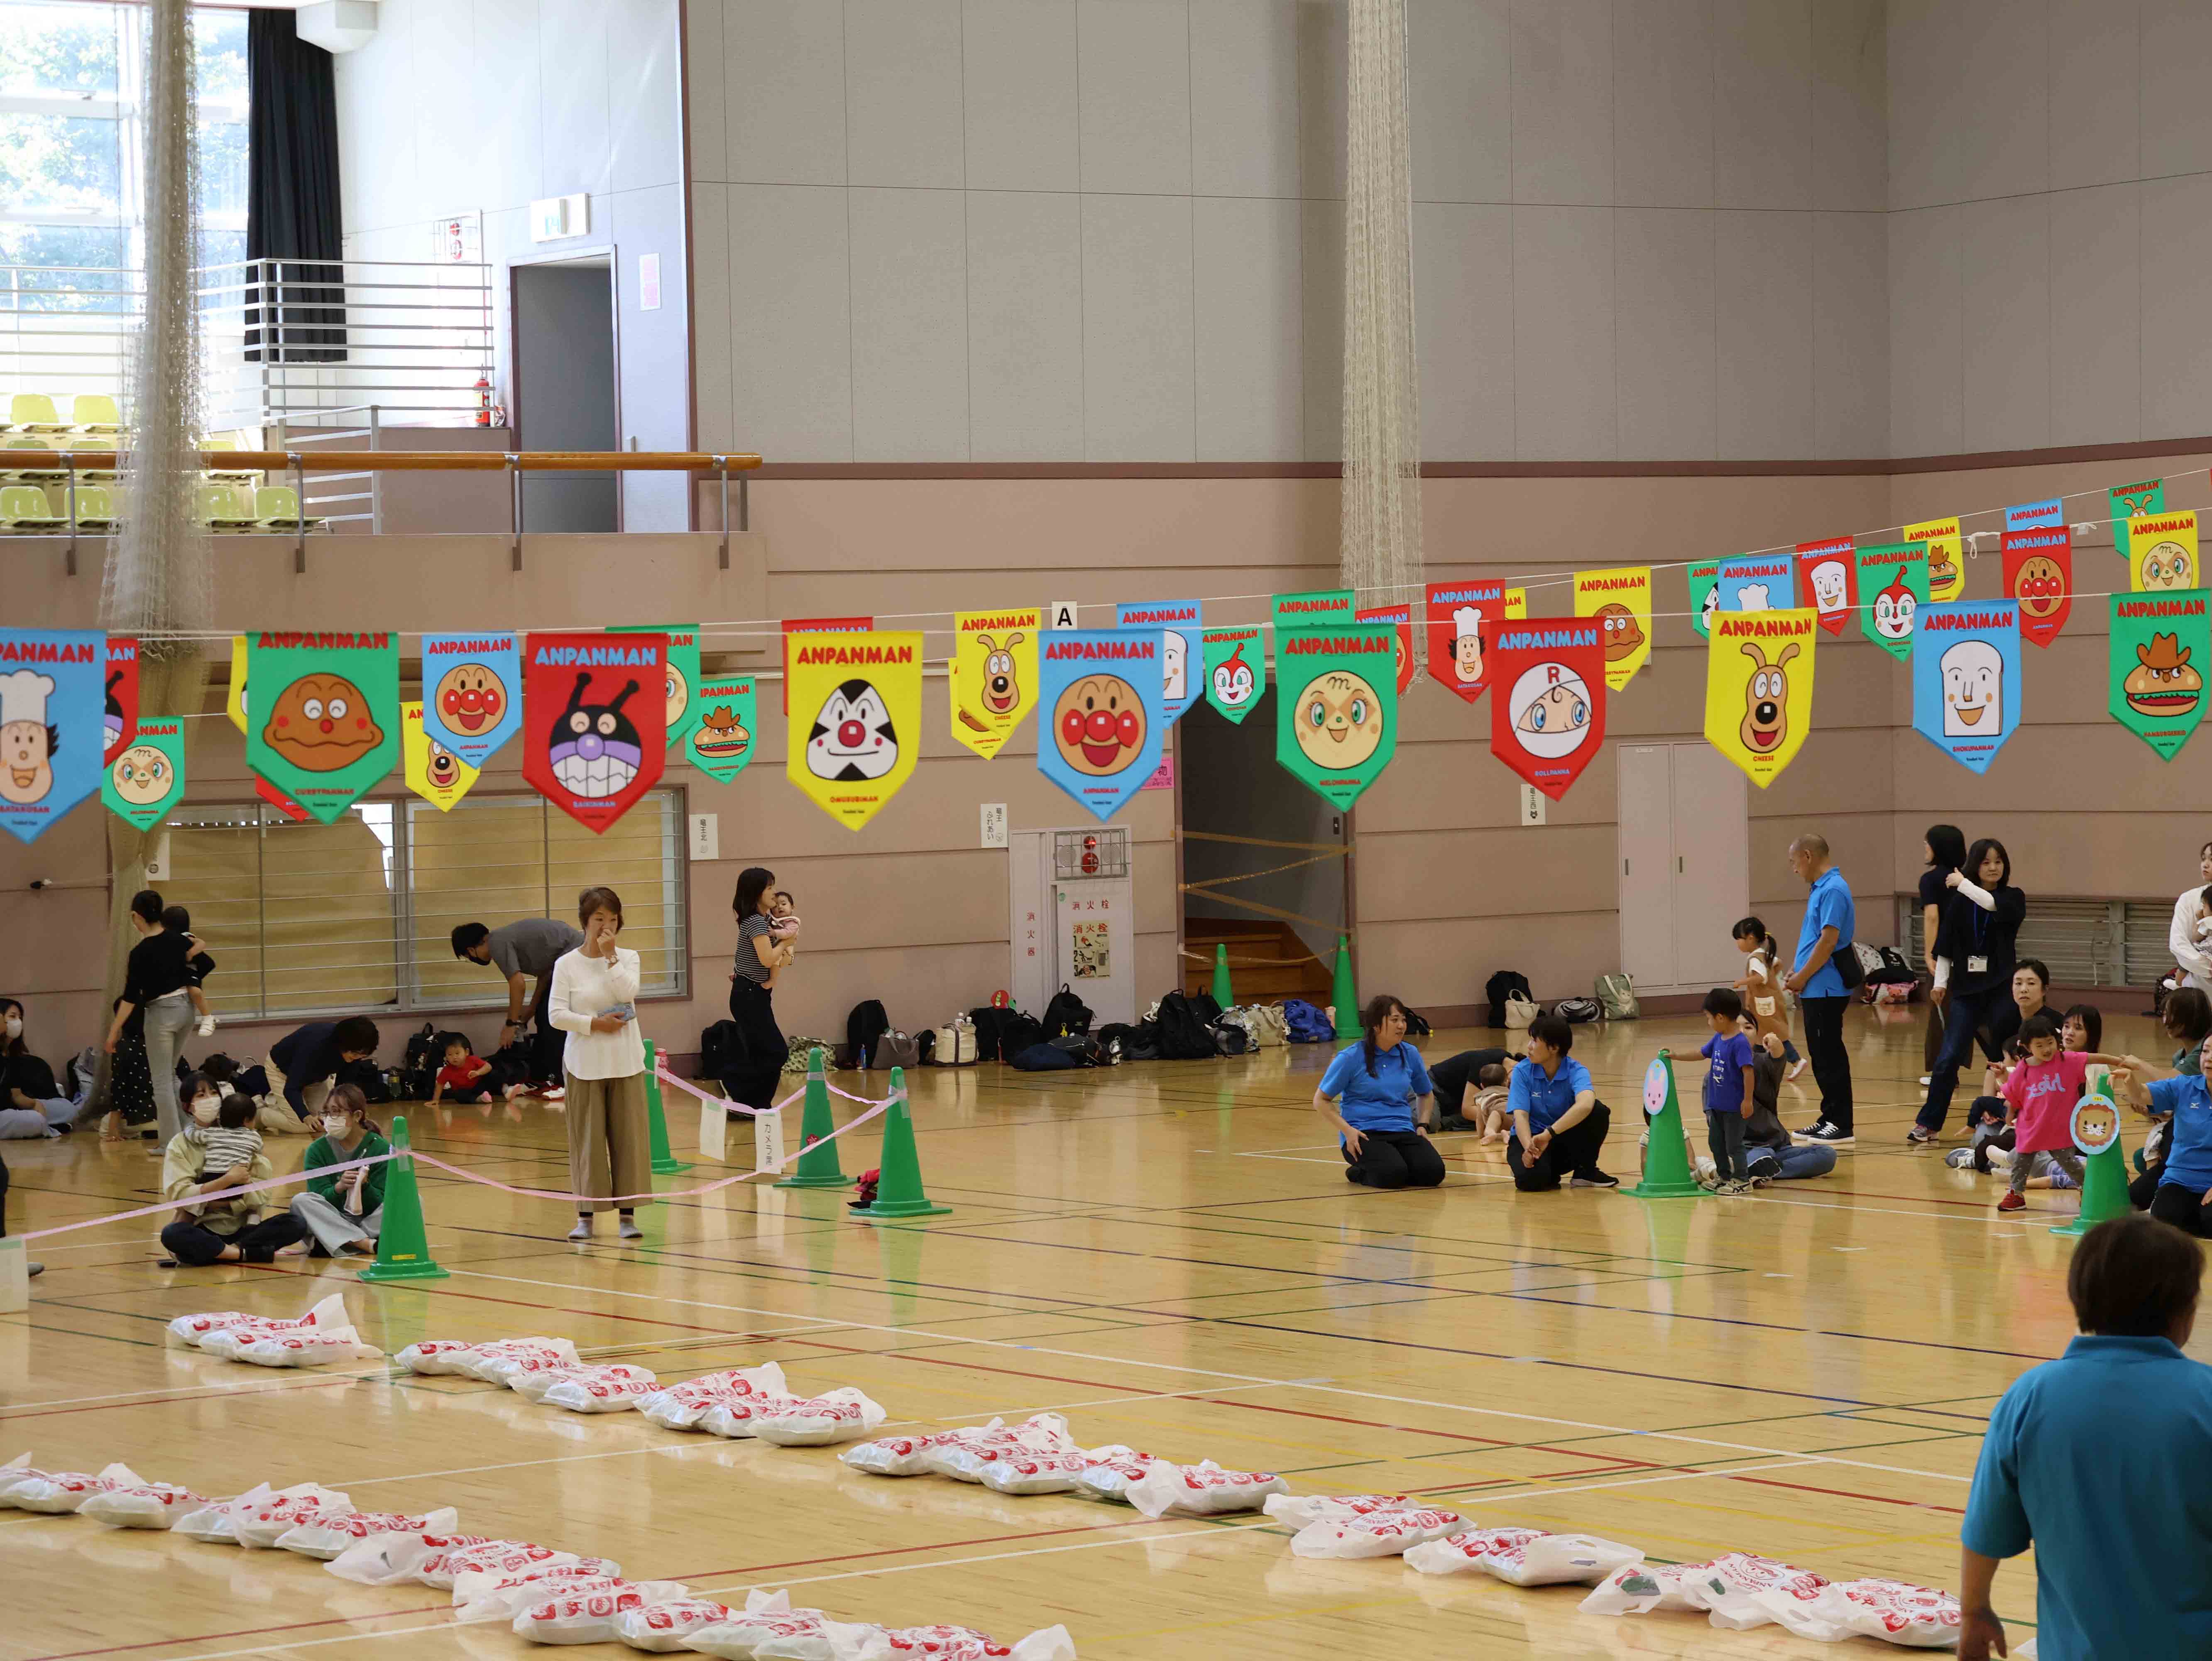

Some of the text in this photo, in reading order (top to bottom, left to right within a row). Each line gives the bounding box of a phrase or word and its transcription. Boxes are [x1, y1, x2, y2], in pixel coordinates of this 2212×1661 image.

[2113, 481, 2159, 497] ANPANMAN
[2011, 506, 2058, 520] ANPANMAN
[1909, 527, 1955, 540] ANPANMAN
[2134, 519, 2193, 534] ANPANMAN
[2007, 534, 2067, 549] ANPANMAN
[1802, 543, 1851, 559] ANPANMAN
[1860, 549, 1924, 567] ANPANMAN
[1724, 564, 1788, 578] ANPANMAN
[1580, 577, 1645, 591] ANPANMAN
[1432, 588, 1500, 603] ANPANMAN
[1278, 599, 1349, 612] ANPANMAN
[2117, 600, 2205, 617] ANPANMAN
[962, 615, 1035, 630] ANPANMAN
[1057, 608, 1072, 626] A
[1123, 608, 1196, 623] ANPANMAN
[1924, 612, 2013, 630] ANPANMAN
[1202, 629, 1258, 643] ANPANMAN
[1719, 620, 1811, 636] ANPANMAN
[257, 630, 389, 649] ANPANMAN
[428, 638, 511, 654] ANPANMAN
[1285, 636, 1389, 654] ANPANMAN
[1498, 629, 1597, 649] ANPANMAN
[0, 642, 94, 663] ANMAN
[535, 647, 657, 665] ANPANMAN
[798, 647, 912, 664] ANPANMAN
[1045, 642, 1154, 659] ANPANMAN
[1073, 900, 1109, 910] 消火栓
[1073, 924, 1108, 933] 消火栓
